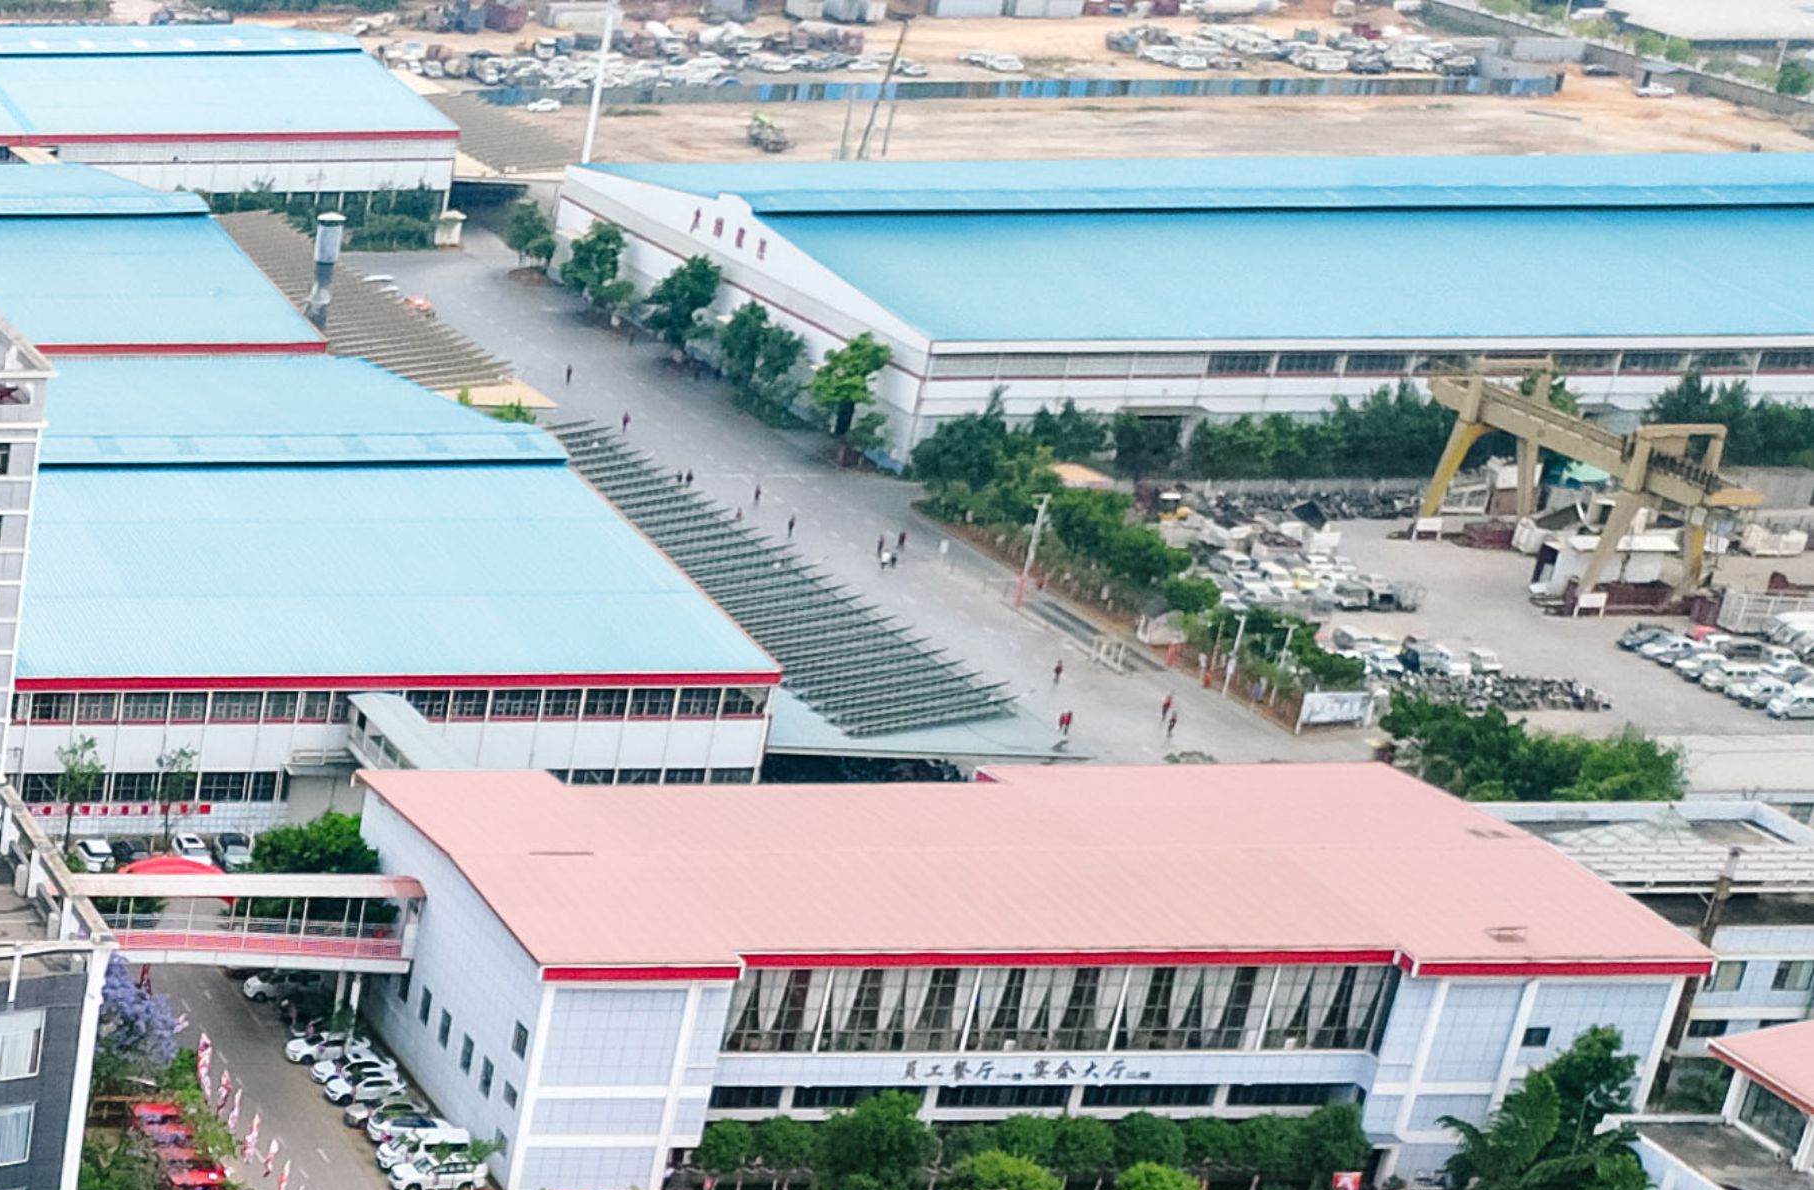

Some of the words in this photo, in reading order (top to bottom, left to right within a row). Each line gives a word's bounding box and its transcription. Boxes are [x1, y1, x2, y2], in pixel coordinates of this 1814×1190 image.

[901, 1060, 995, 1081] 员工餐厅
[1028, 1059, 1126, 1081] 宴会大厅
